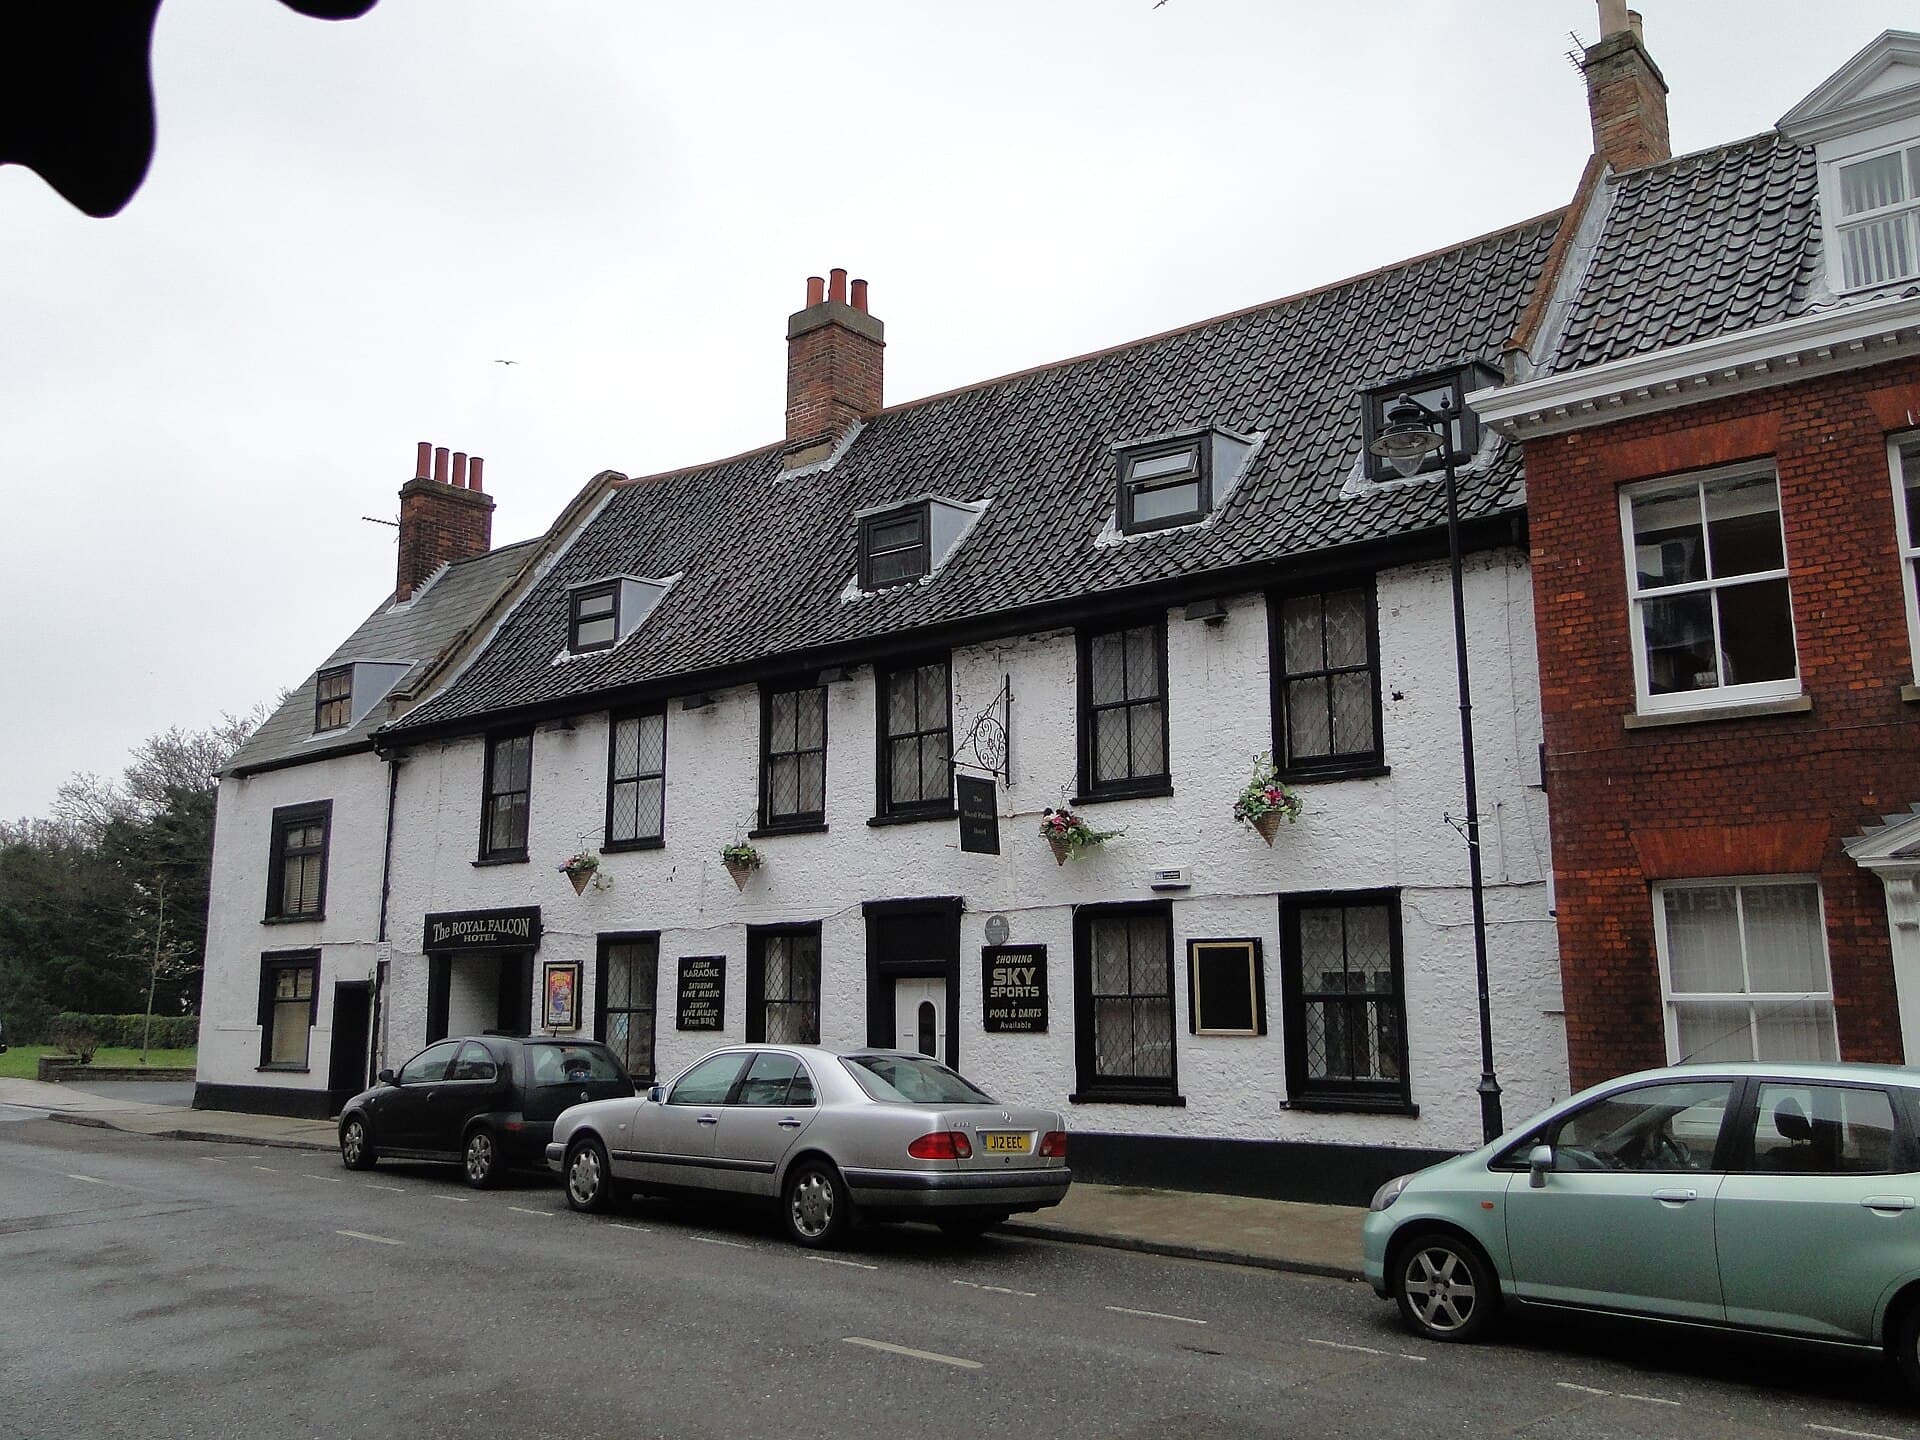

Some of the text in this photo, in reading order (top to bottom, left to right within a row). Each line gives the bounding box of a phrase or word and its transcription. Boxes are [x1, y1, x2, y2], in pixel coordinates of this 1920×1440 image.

[433, 918, 530, 942] The ROYAL FALCON
[463, 934, 496, 942] HOTEL
[995, 954, 1033, 965] SHOWING
[683, 969, 719, 978] KARAOKE
[993, 968, 1036, 985] SKY
[682, 990, 720, 998] LIVE MUSIC
[990, 986, 1040, 998] SPORTS
[682, 1008, 719, 1017] LIVE MUSIC
[989, 1008, 1042, 1018] POOL & DARTS
[1000, 1020, 1032, 1029] Available
[991, 1136, 1022, 1148] J12 EEC
